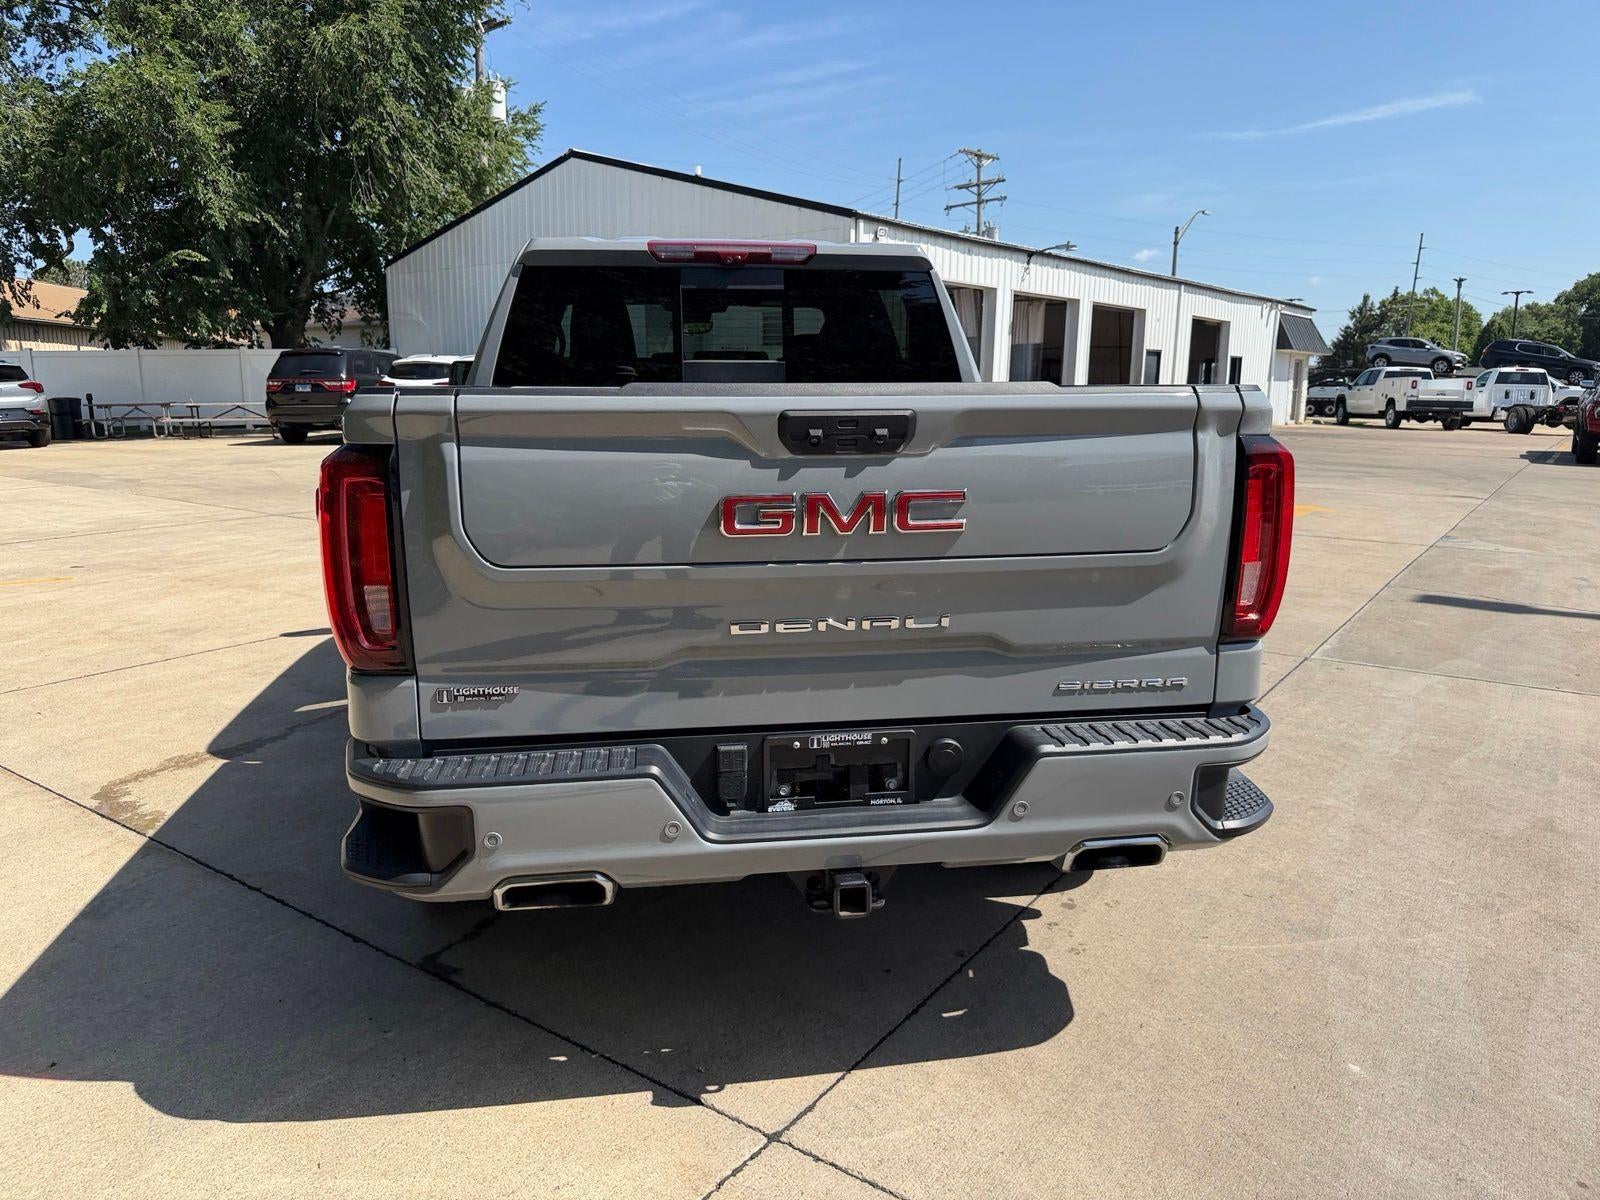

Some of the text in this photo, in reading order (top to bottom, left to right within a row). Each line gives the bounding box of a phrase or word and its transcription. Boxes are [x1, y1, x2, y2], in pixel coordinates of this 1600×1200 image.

[719, 488, 968, 537] GMC
[729, 613, 950, 635] DENALI
[1057, 676, 1188, 690] SIERRA
[453, 686, 520, 696] LIGHTHOUSE
[822, 732, 873, 742] LIGHTHOUSE
